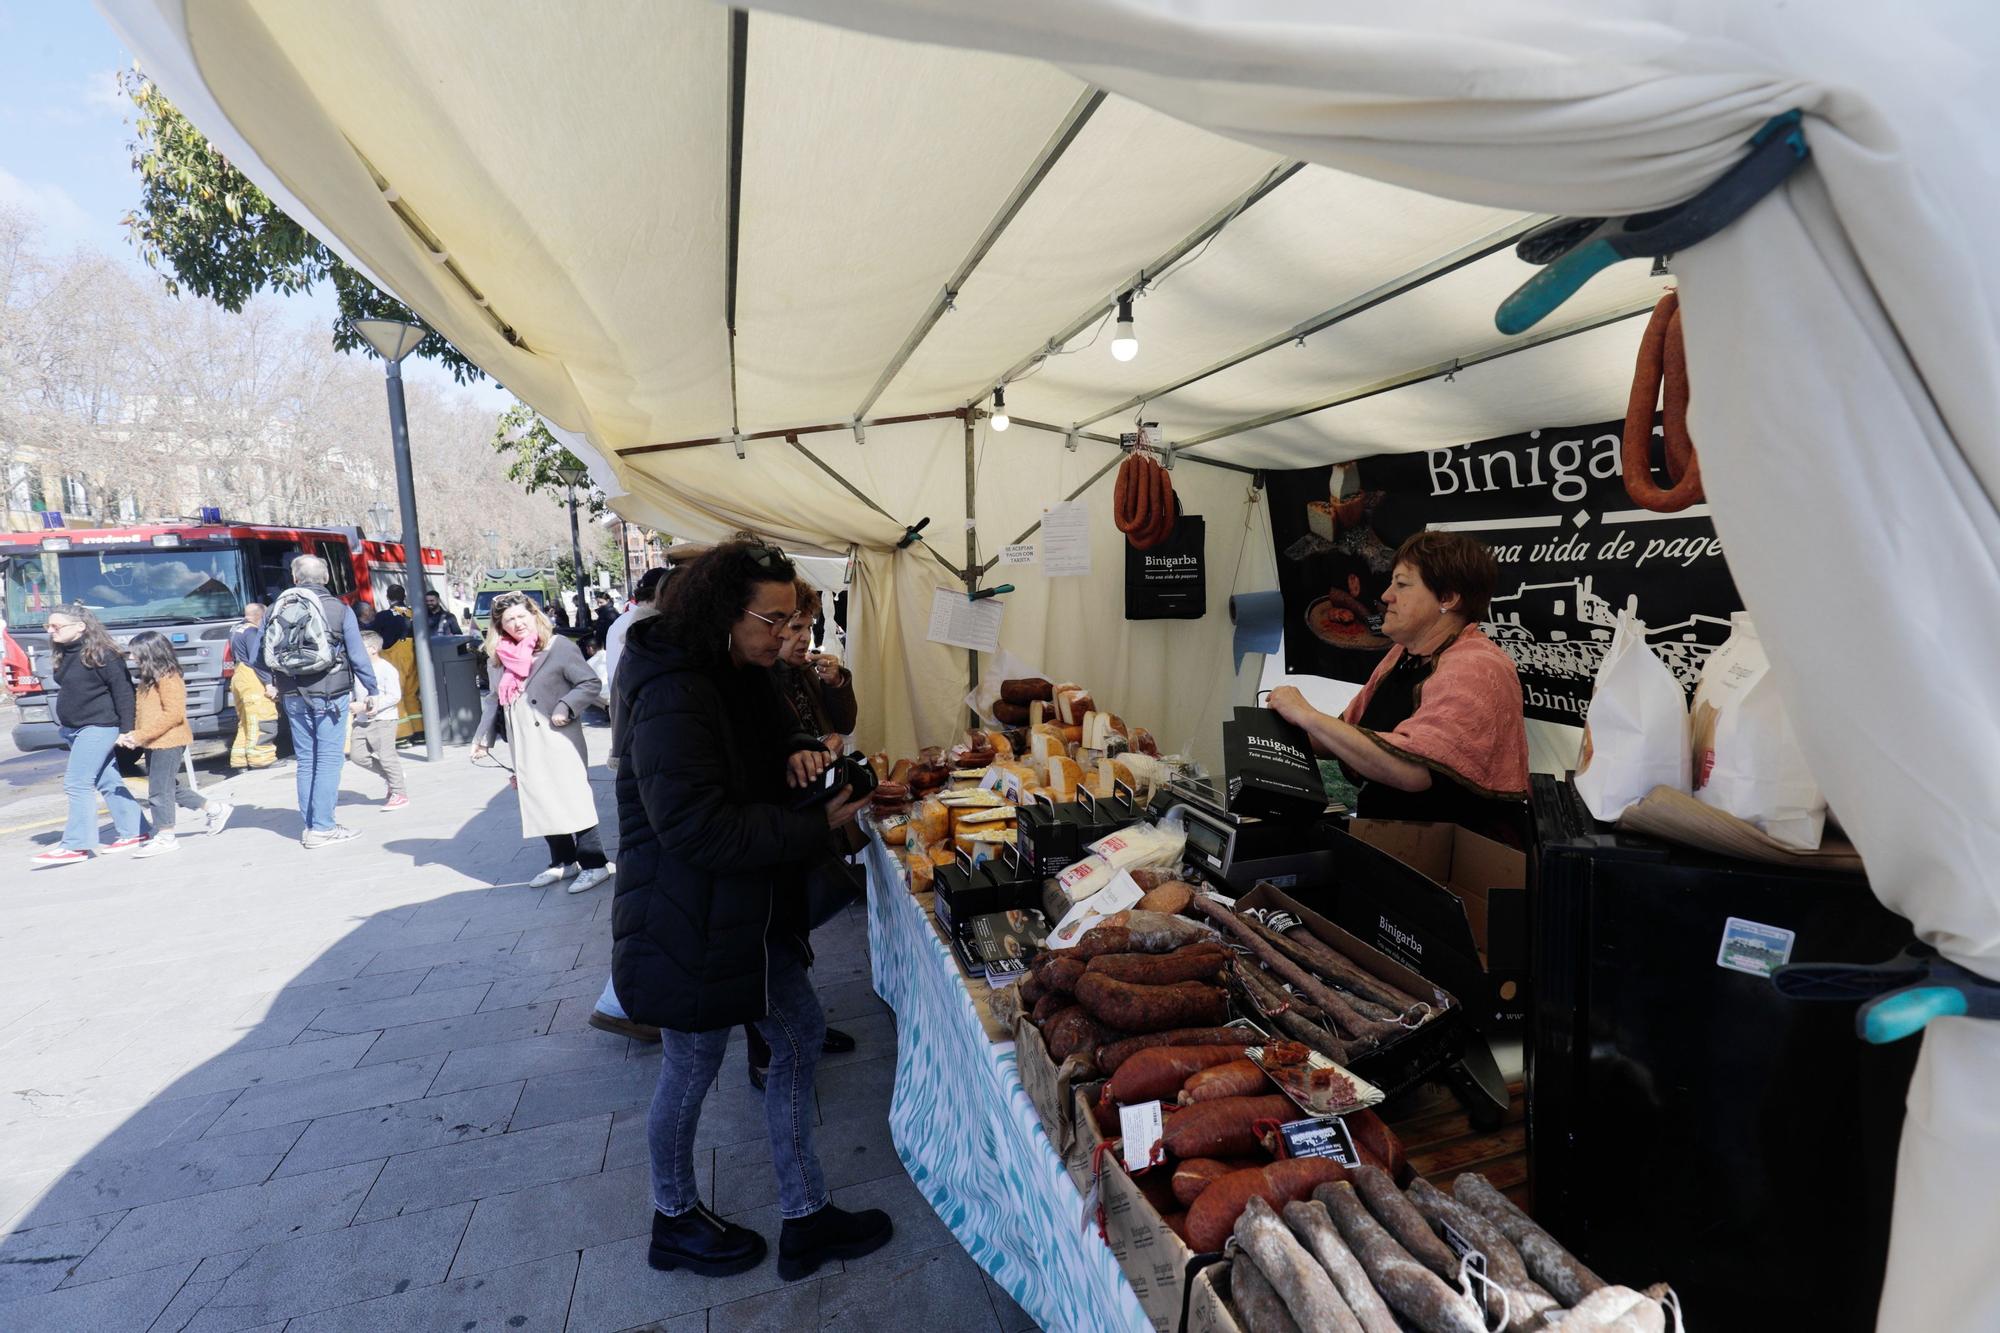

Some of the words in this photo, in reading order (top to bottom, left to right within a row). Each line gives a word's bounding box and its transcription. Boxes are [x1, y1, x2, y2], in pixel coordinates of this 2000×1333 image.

[1529, 532, 1591, 563] vida
[1597, 530, 1635, 561] de
[1145, 554, 1198, 568] Binigarba
[1247, 736, 1306, 760] Binigarba
[1379, 915, 1423, 955] Binigarba
